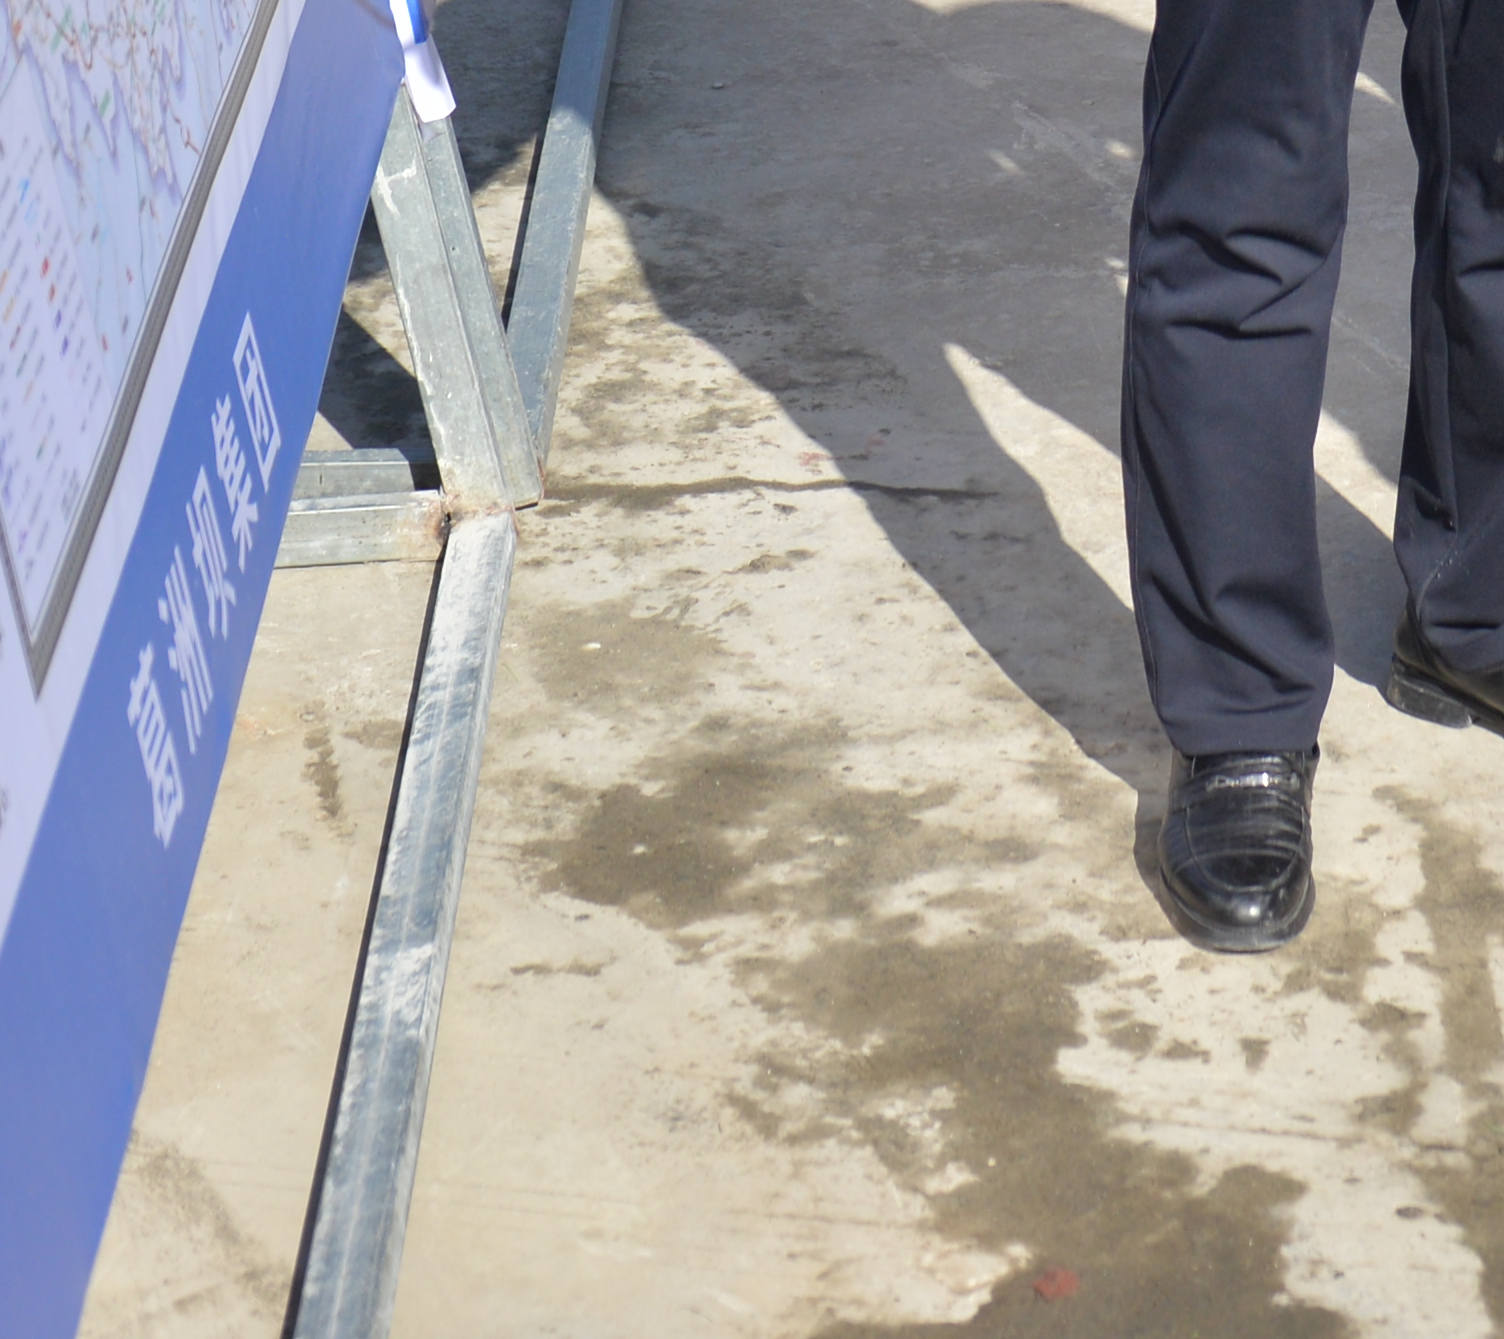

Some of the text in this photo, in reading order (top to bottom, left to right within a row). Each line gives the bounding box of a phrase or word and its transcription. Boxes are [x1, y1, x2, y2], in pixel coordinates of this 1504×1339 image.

[126, 310, 281, 849] 葛洲坝集团
